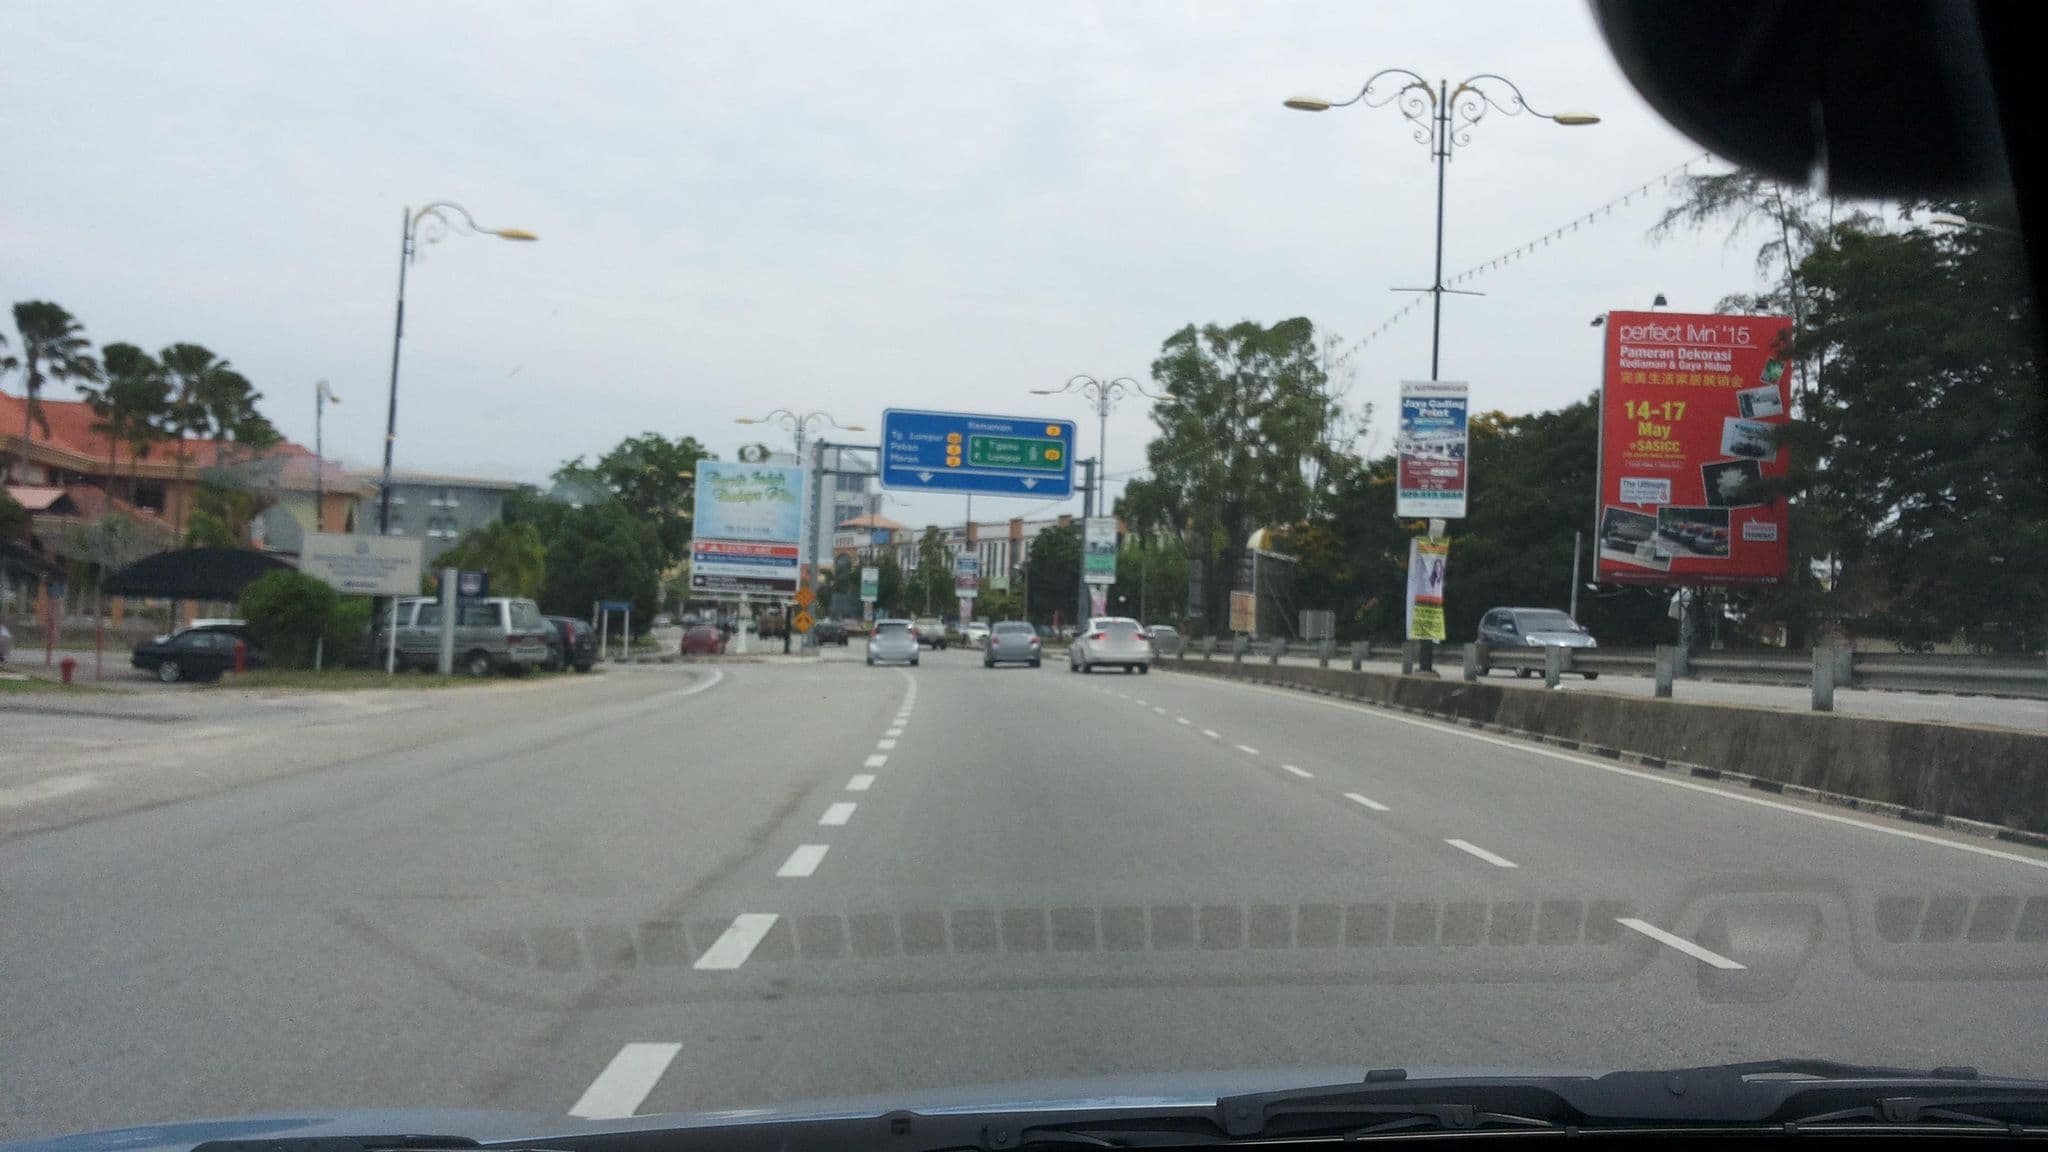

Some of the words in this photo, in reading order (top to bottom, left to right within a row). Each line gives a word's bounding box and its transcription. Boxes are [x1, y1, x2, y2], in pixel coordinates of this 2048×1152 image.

[1620, 323, 1681, 342] perfect
[1620, 346, 1674, 359] Pameran
[1678, 348, 1732, 361] Dekorasi
[1620, 359, 1666, 369] Kediaman
[1669, 361, 1676, 370] &
[1679, 361, 1702, 372] Gaya
[1704, 362, 1732, 373] Hidup
[1403, 399, 1427, 409] Jaya
[1428, 399, 1465, 410] Gading
[1625, 399, 1686, 421] 14-17
[1419, 408, 1449, 417] Point
[1638, 421, 1671, 440] May
